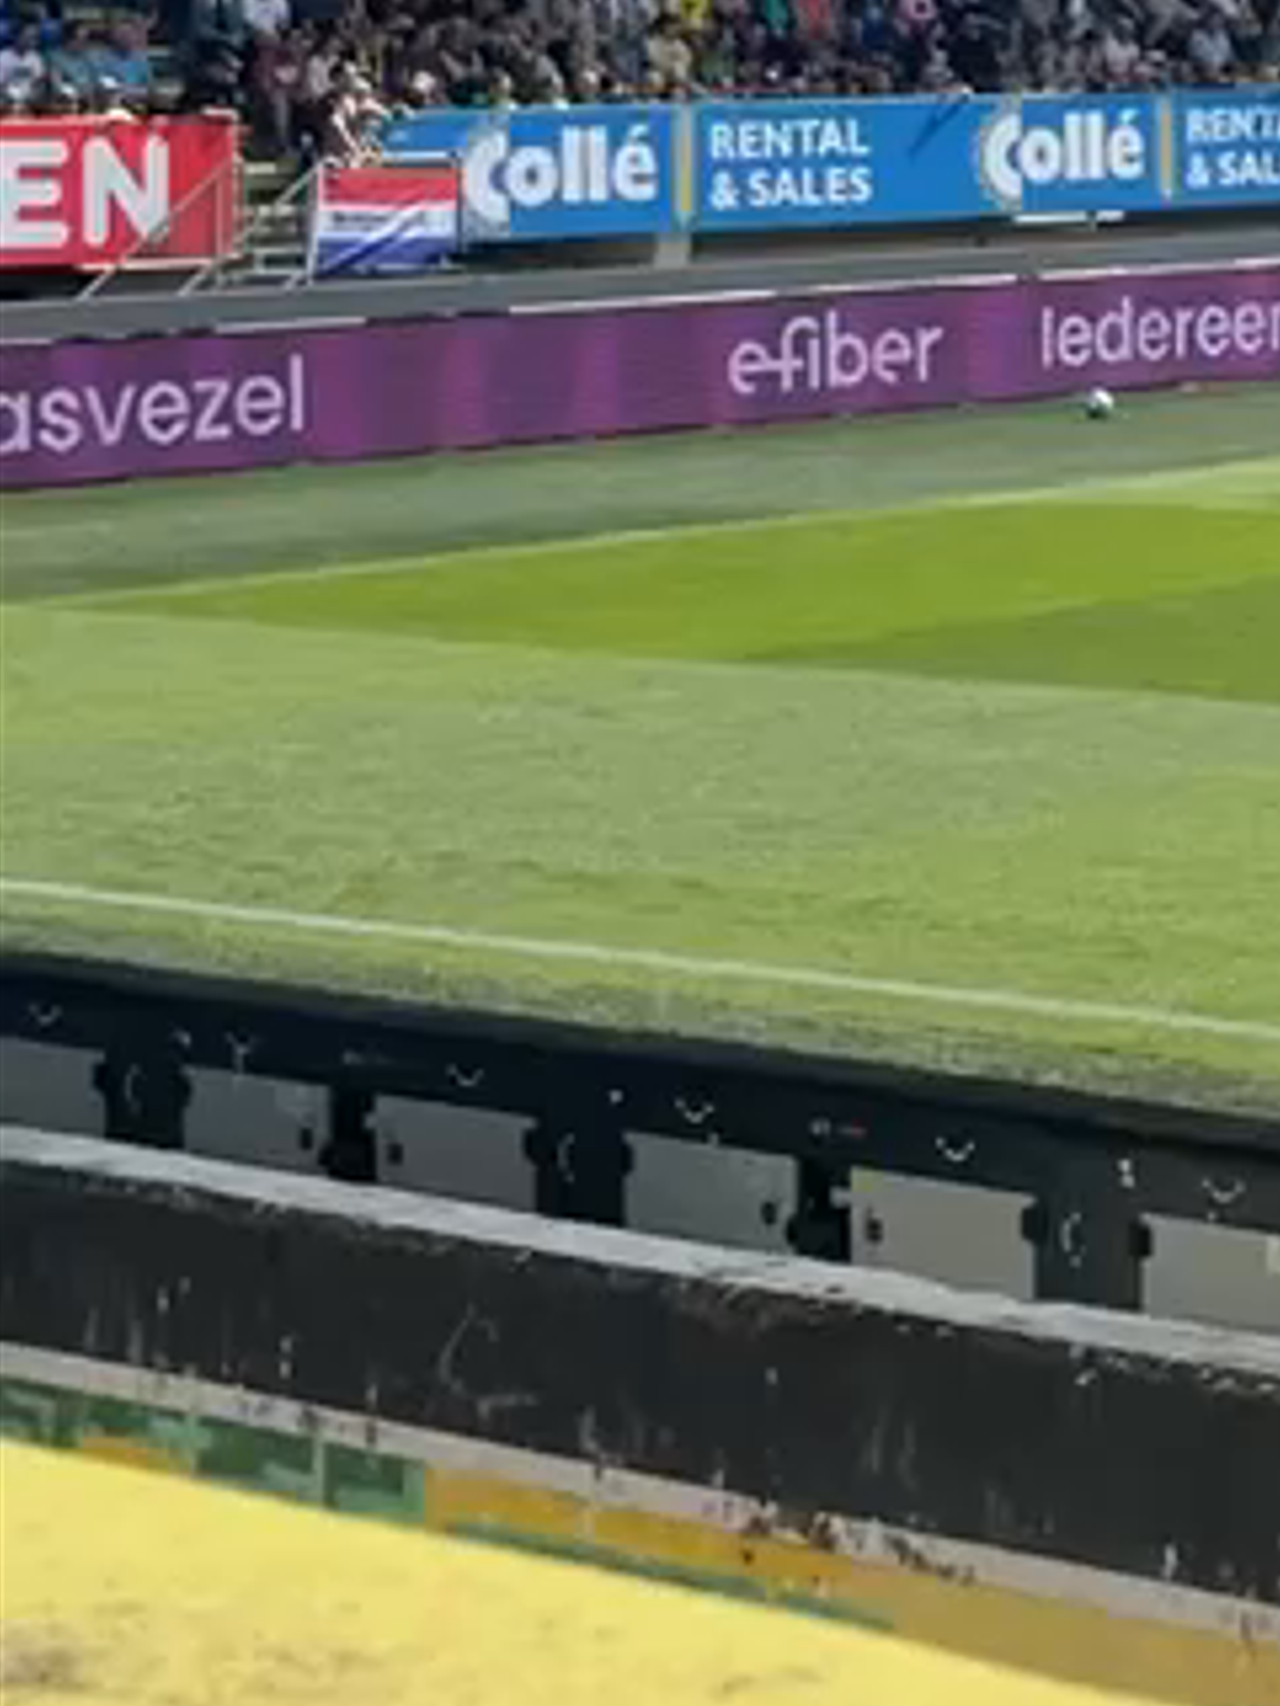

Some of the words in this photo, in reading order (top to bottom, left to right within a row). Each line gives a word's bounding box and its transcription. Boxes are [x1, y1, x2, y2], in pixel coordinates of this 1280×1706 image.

[710, 116, 870, 161] RENTAL
[979, 105, 1146, 216] Collé
[461, 125, 658, 227] Collé
[710, 167, 737, 211] &
[747, 163, 874, 207] SALES
[1186, 150, 1208, 189] &
